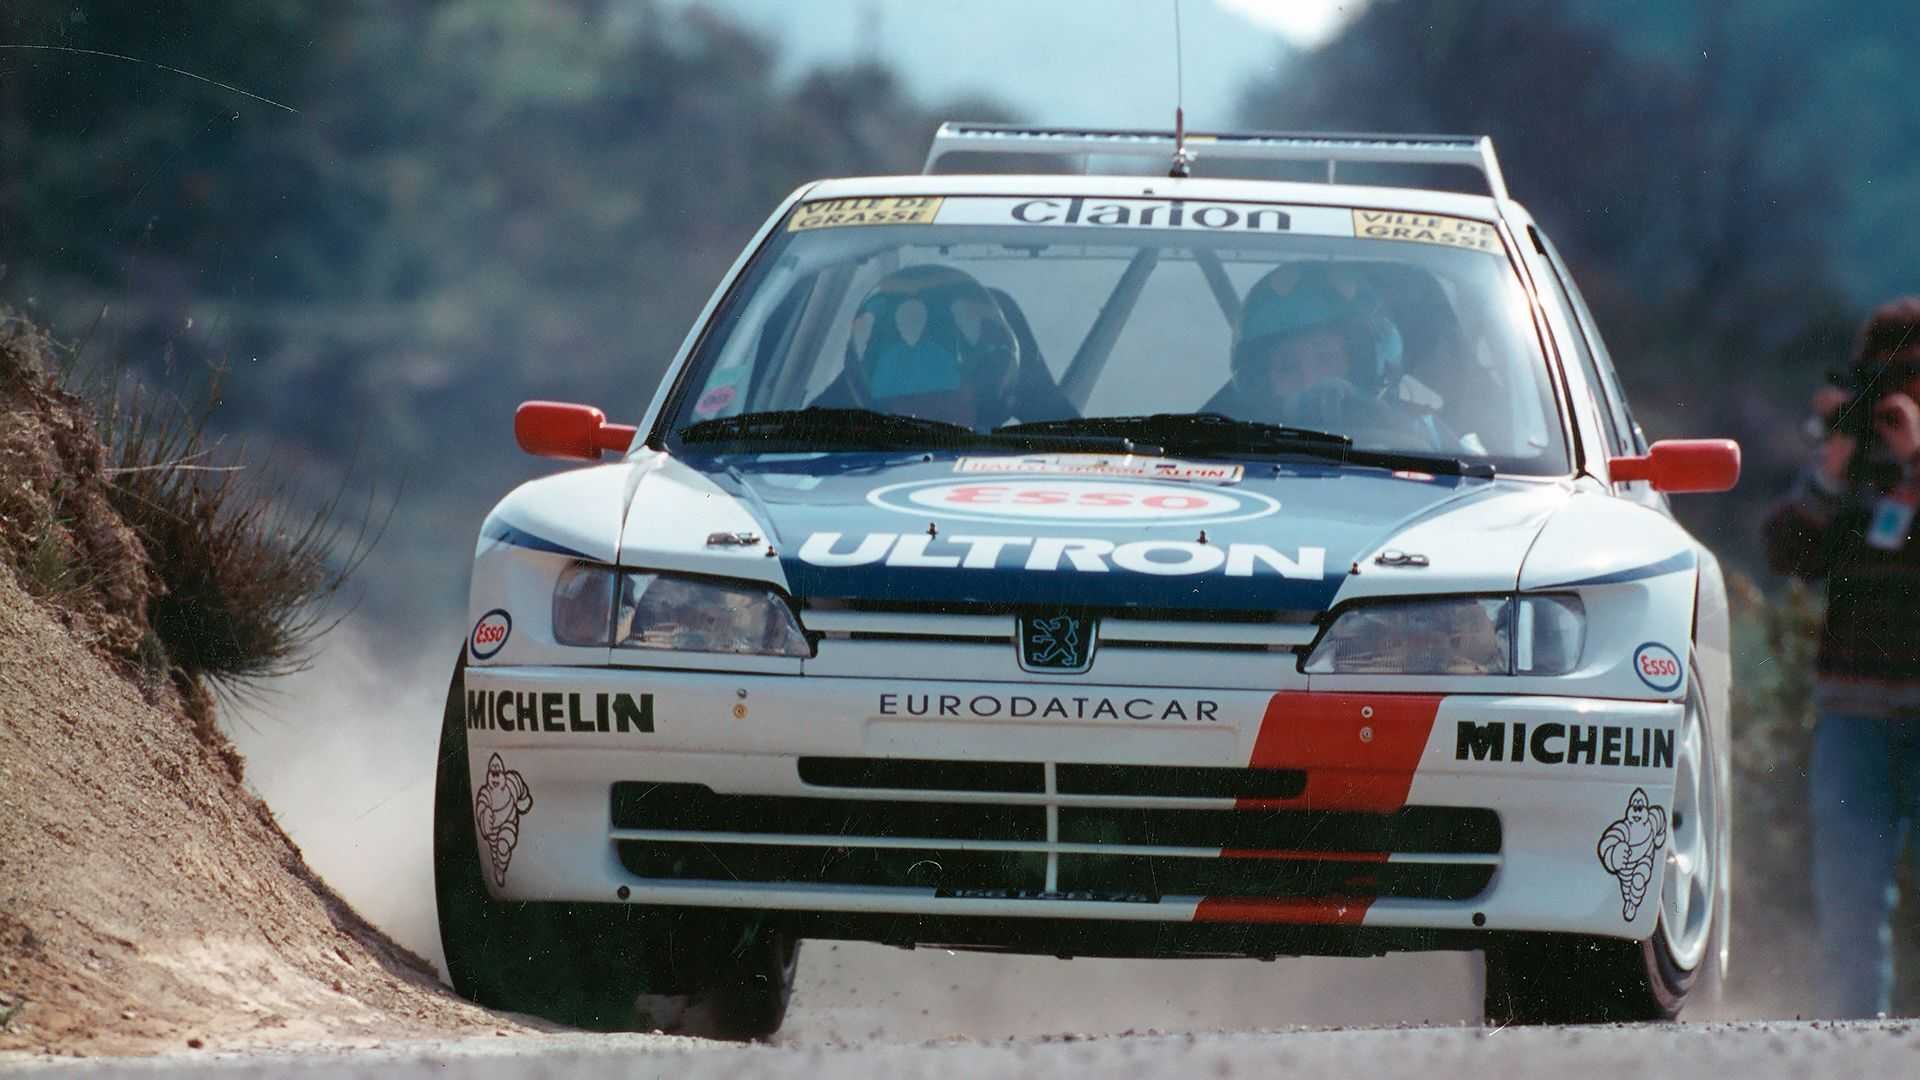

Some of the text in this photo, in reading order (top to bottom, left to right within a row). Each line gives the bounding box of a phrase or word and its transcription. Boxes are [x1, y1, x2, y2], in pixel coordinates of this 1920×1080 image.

[799, 211, 926, 227] GRASSE
[1010, 198, 1291, 231] Clarion
[1362, 212, 1441, 227] VILLE
[1364, 225, 1490, 248] GRASSE
[798, 532, 1325, 580] ULTRON
[467, 690, 655, 733] MICHELIN
[879, 693, 1219, 721] EURODATACAR
[1455, 720, 1675, 768] MICHELIN
